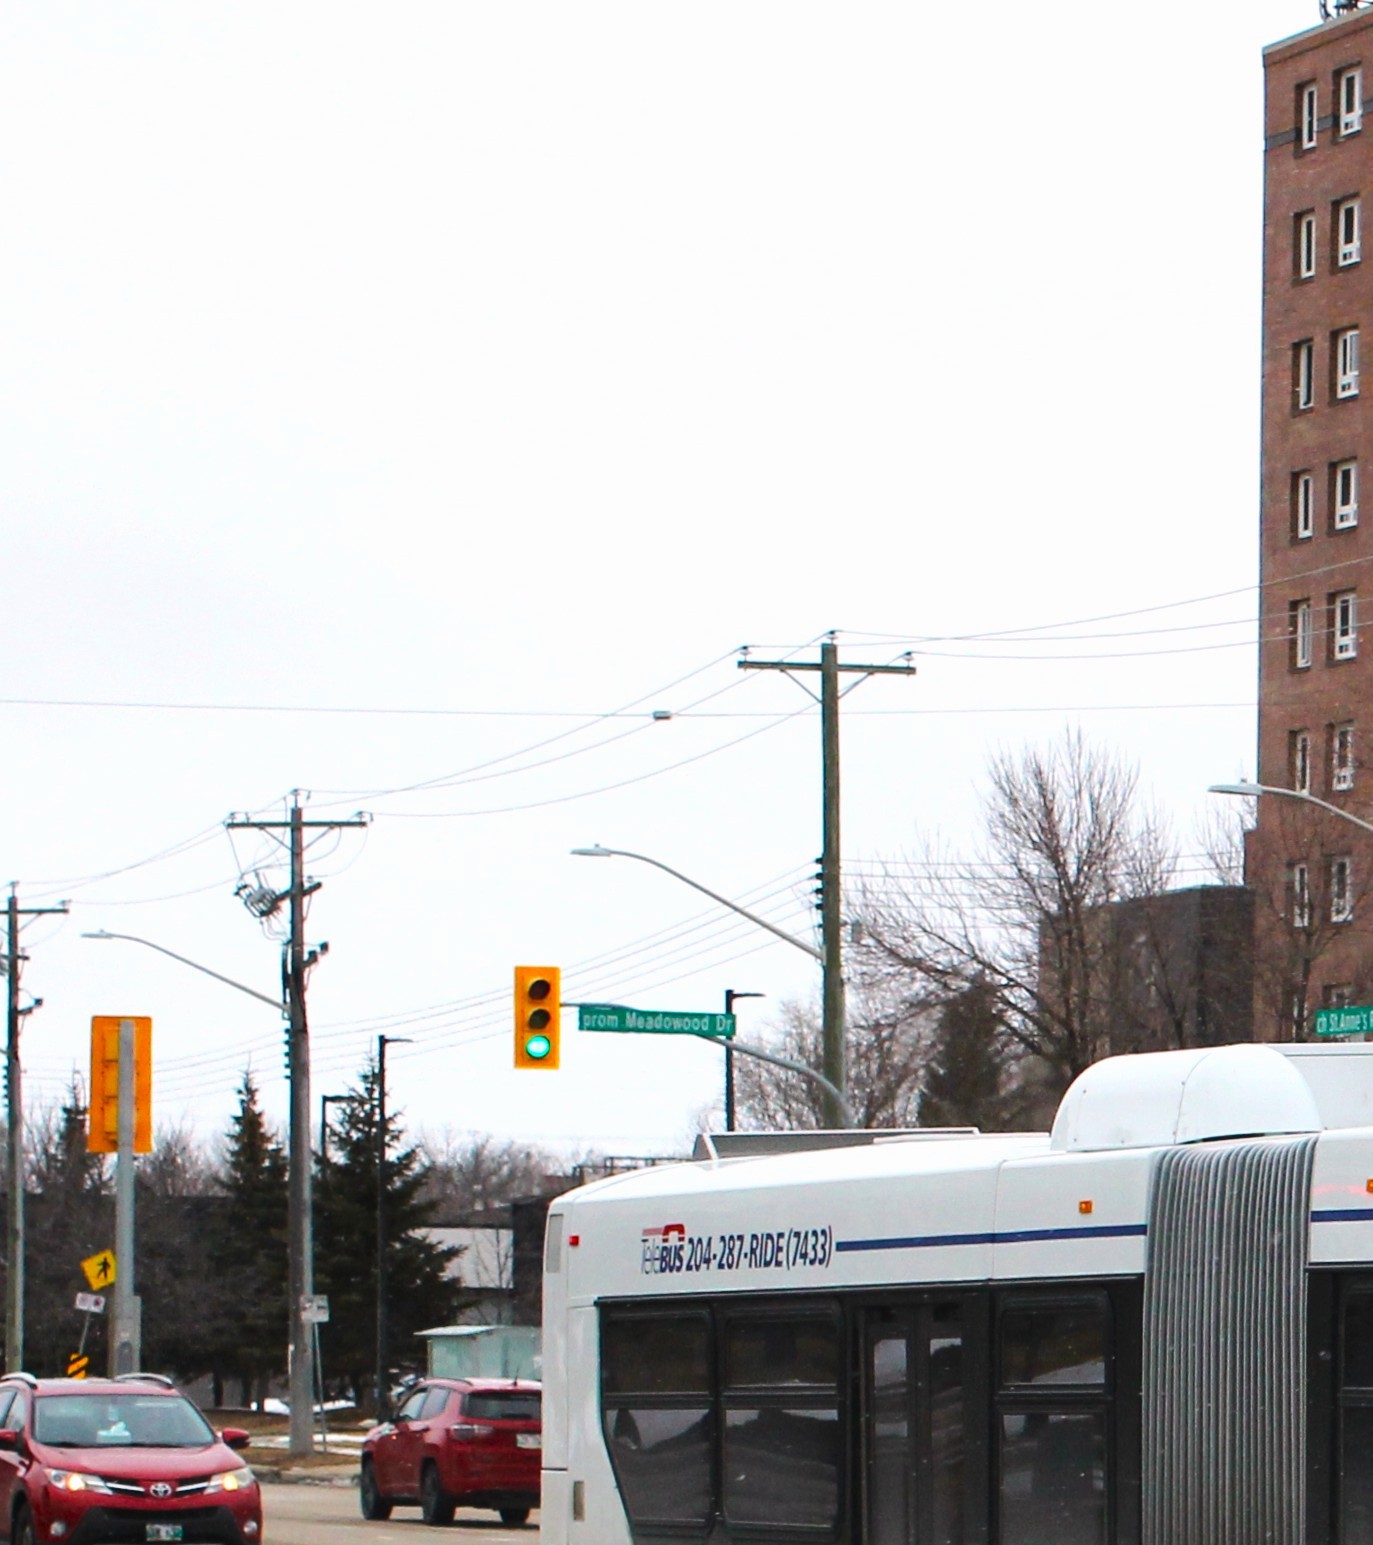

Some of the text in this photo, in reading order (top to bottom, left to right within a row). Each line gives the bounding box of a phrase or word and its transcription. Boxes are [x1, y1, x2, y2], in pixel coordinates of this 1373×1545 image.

[583, 1011, 733, 1031] prom Meadowood Dr
[685, 1233, 784, 1272] 204-287-RIDE
[785, 1224, 833, 1271] (7433)
